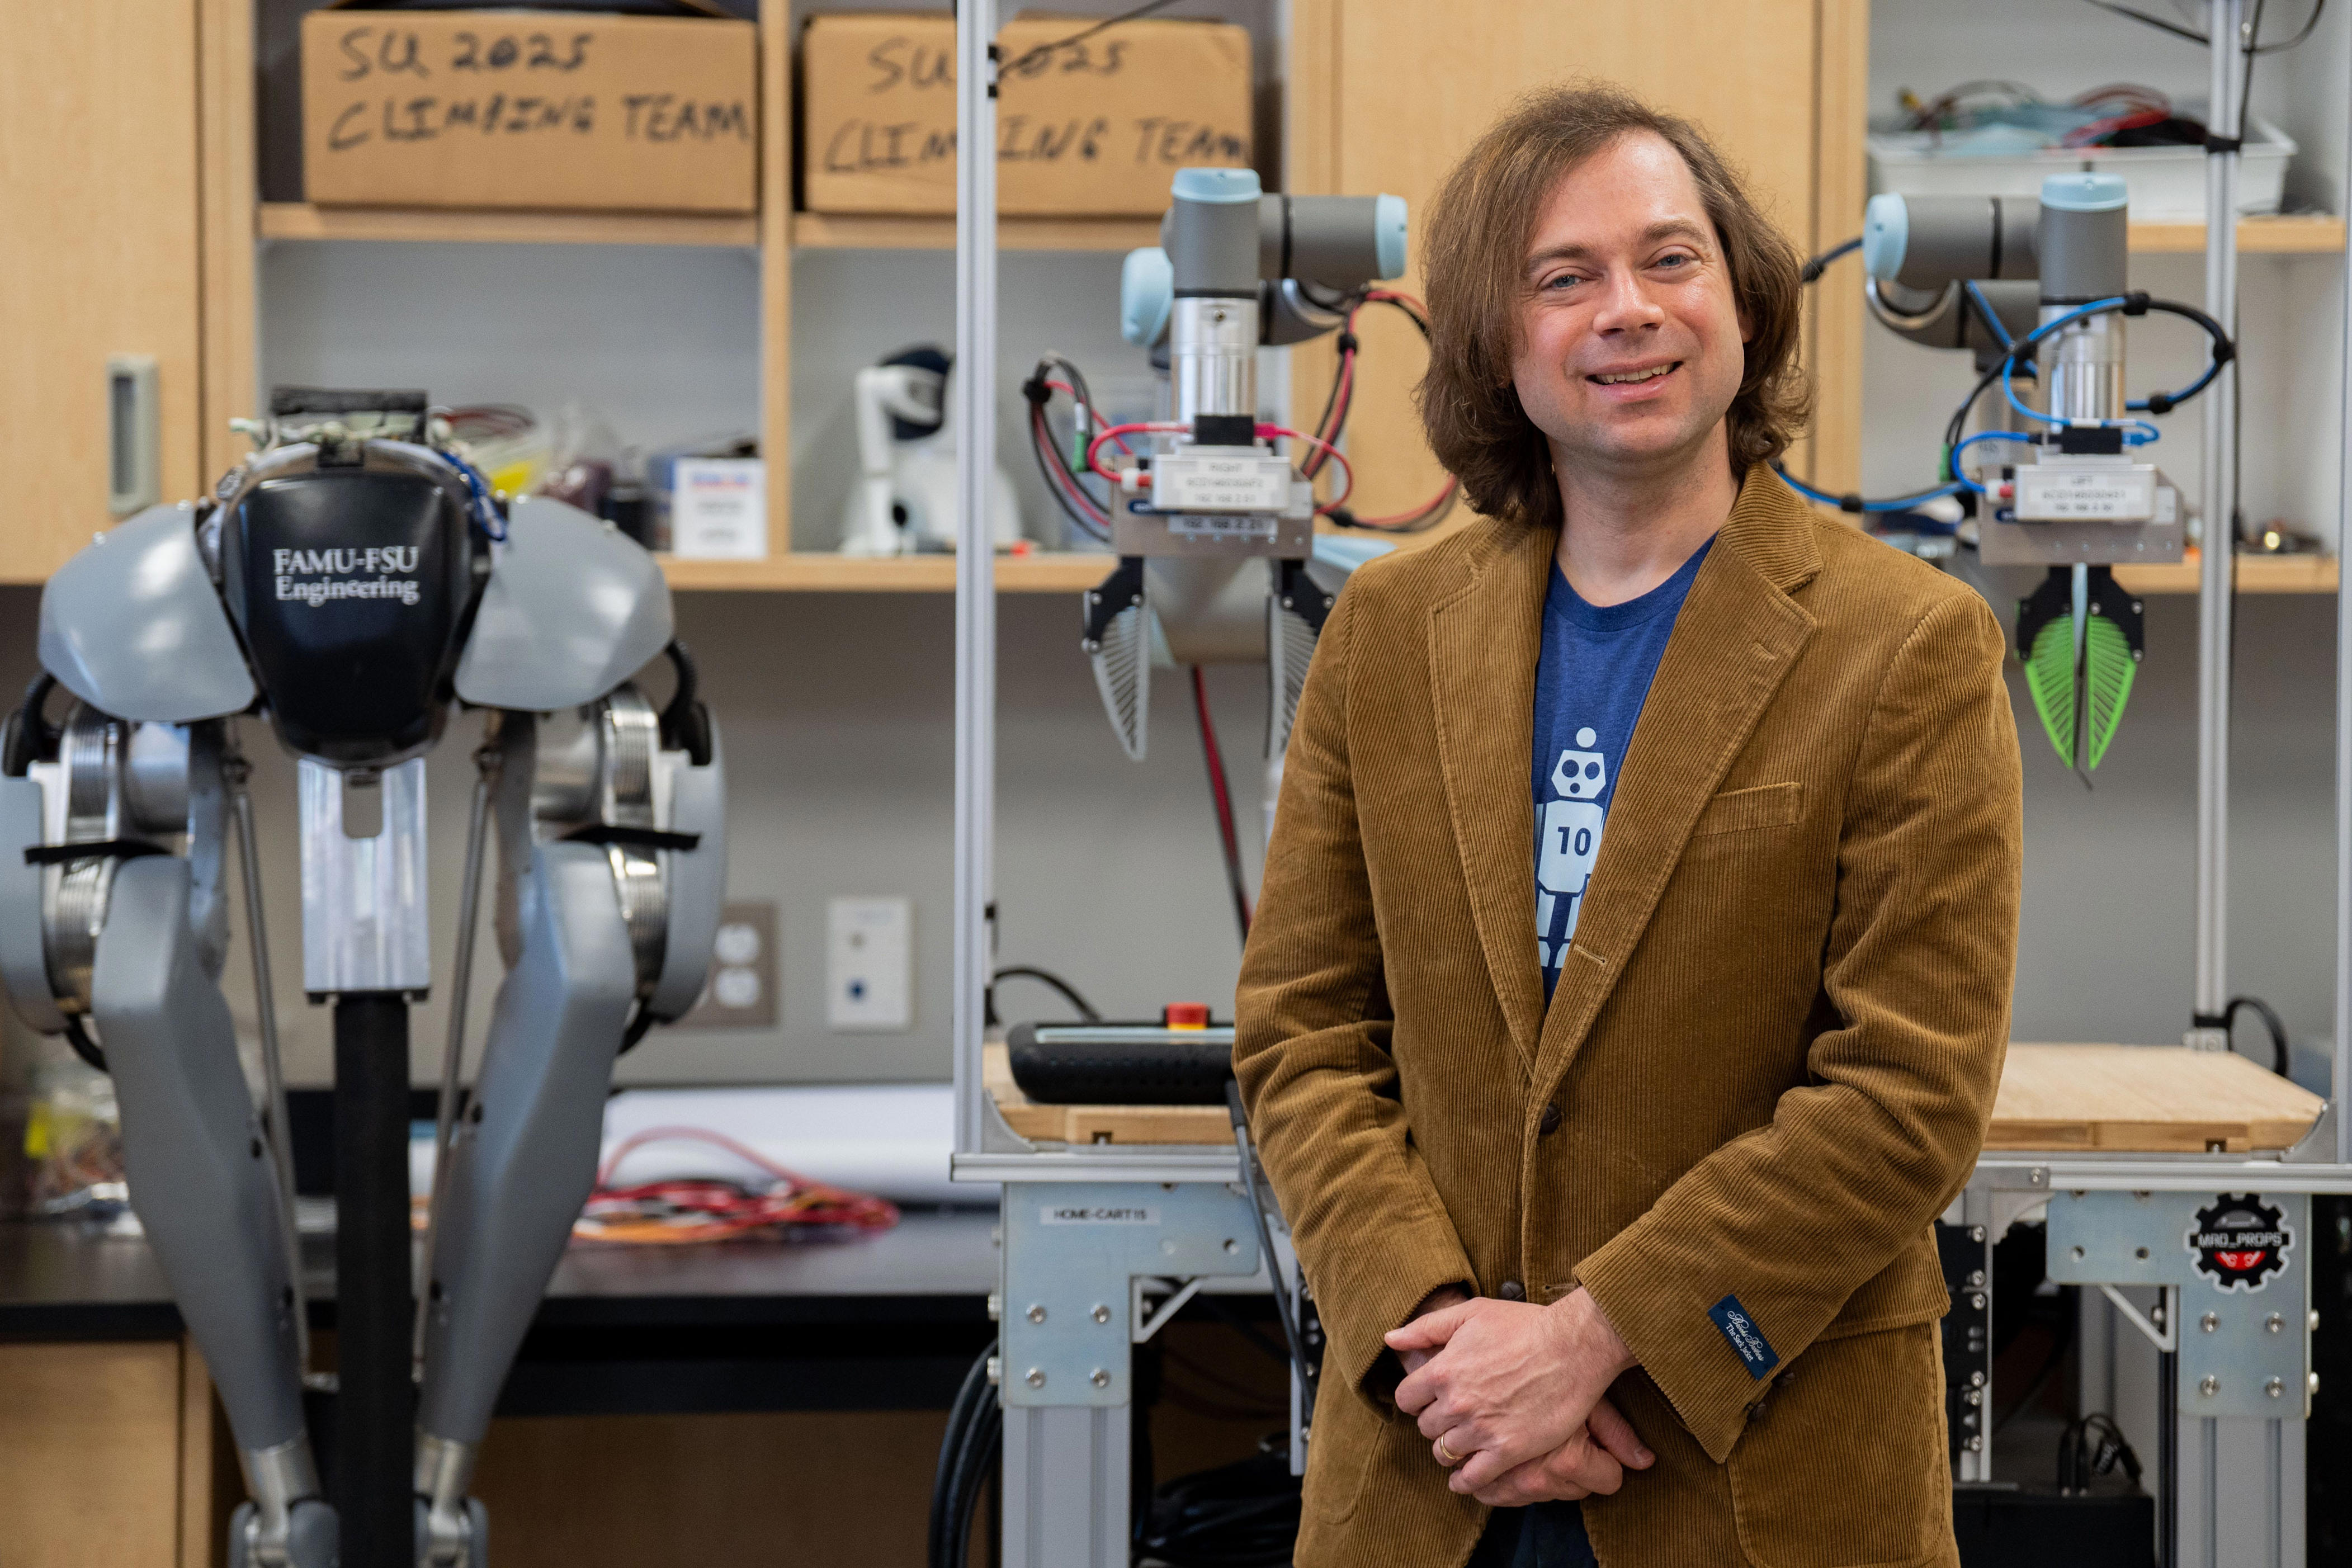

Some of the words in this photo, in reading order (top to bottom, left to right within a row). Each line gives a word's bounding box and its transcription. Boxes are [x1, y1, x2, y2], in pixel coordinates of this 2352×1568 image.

[452, 32, 595, 72] 2025
[1000, 40, 1131, 81] 025
[621, 92, 751, 143] TEAM
[822, 115, 1110, 172] CLIMING
[1134, 116, 1251, 164] TEAM
[273, 545, 419, 575] FAMU-FSU
[276, 574, 421, 607] Engineering
[1557, 826, 1591, 856] 10
[1726, 1323, 1736, 1336] The
[1734, 1334, 1745, 1348] Sack
[1727, 1311, 1749, 1337] Brooks
[1745, 1335, 1764, 1361] Brothers
